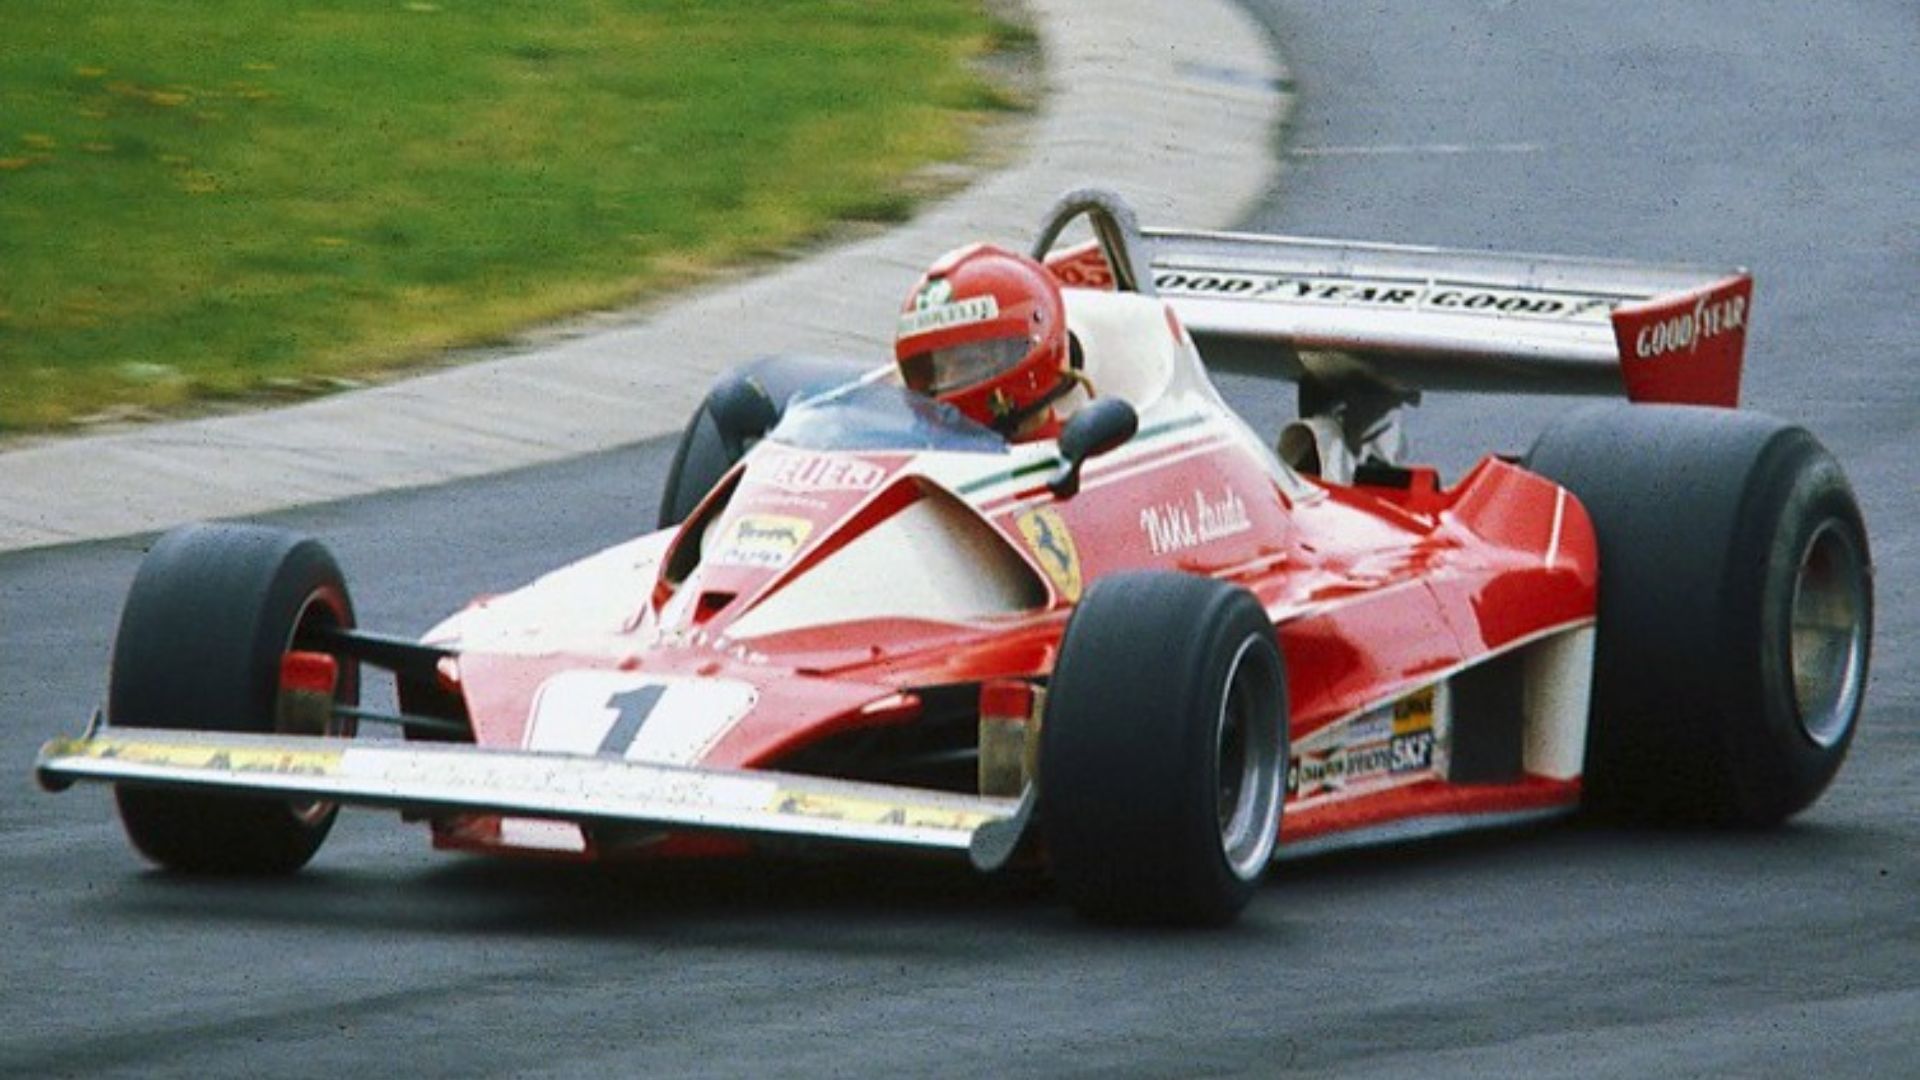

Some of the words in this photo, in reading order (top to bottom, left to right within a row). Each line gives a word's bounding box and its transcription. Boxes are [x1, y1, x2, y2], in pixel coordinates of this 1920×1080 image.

[1153, 272, 1249, 293] OOD
[1431, 291, 1564, 313] GOOD
[597, 684, 668, 757] 1
[1392, 731, 1435, 771] SKF
